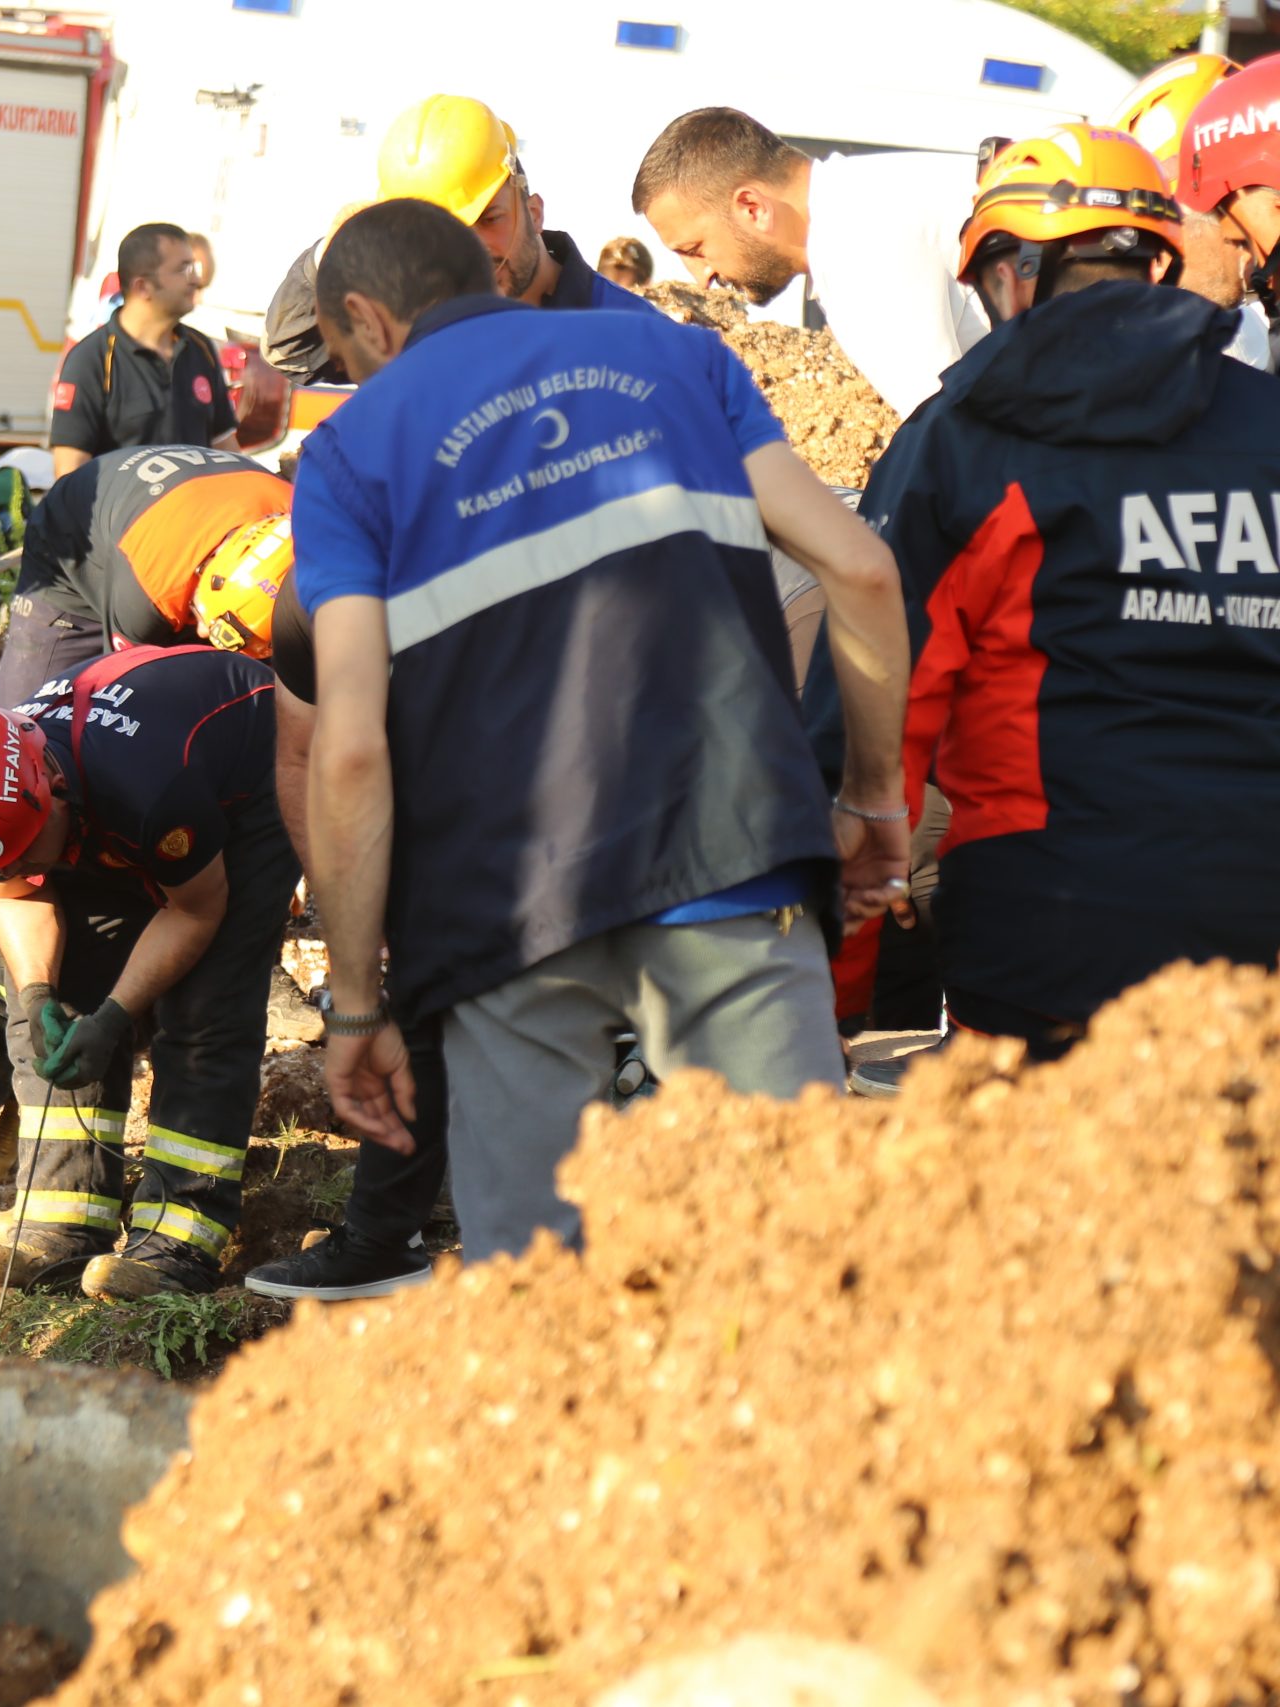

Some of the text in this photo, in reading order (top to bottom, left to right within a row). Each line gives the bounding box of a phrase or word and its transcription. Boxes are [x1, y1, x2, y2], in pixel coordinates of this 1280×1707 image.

[434, 365, 657, 468] KASTAMONU BELEDİYESİ
[456, 475, 526, 519] KASKİ
[1118, 489, 1280, 574] AFA
[1122, 587, 1212, 625] ARAMA
[0, 723, 20, 803] İTFAİYE
